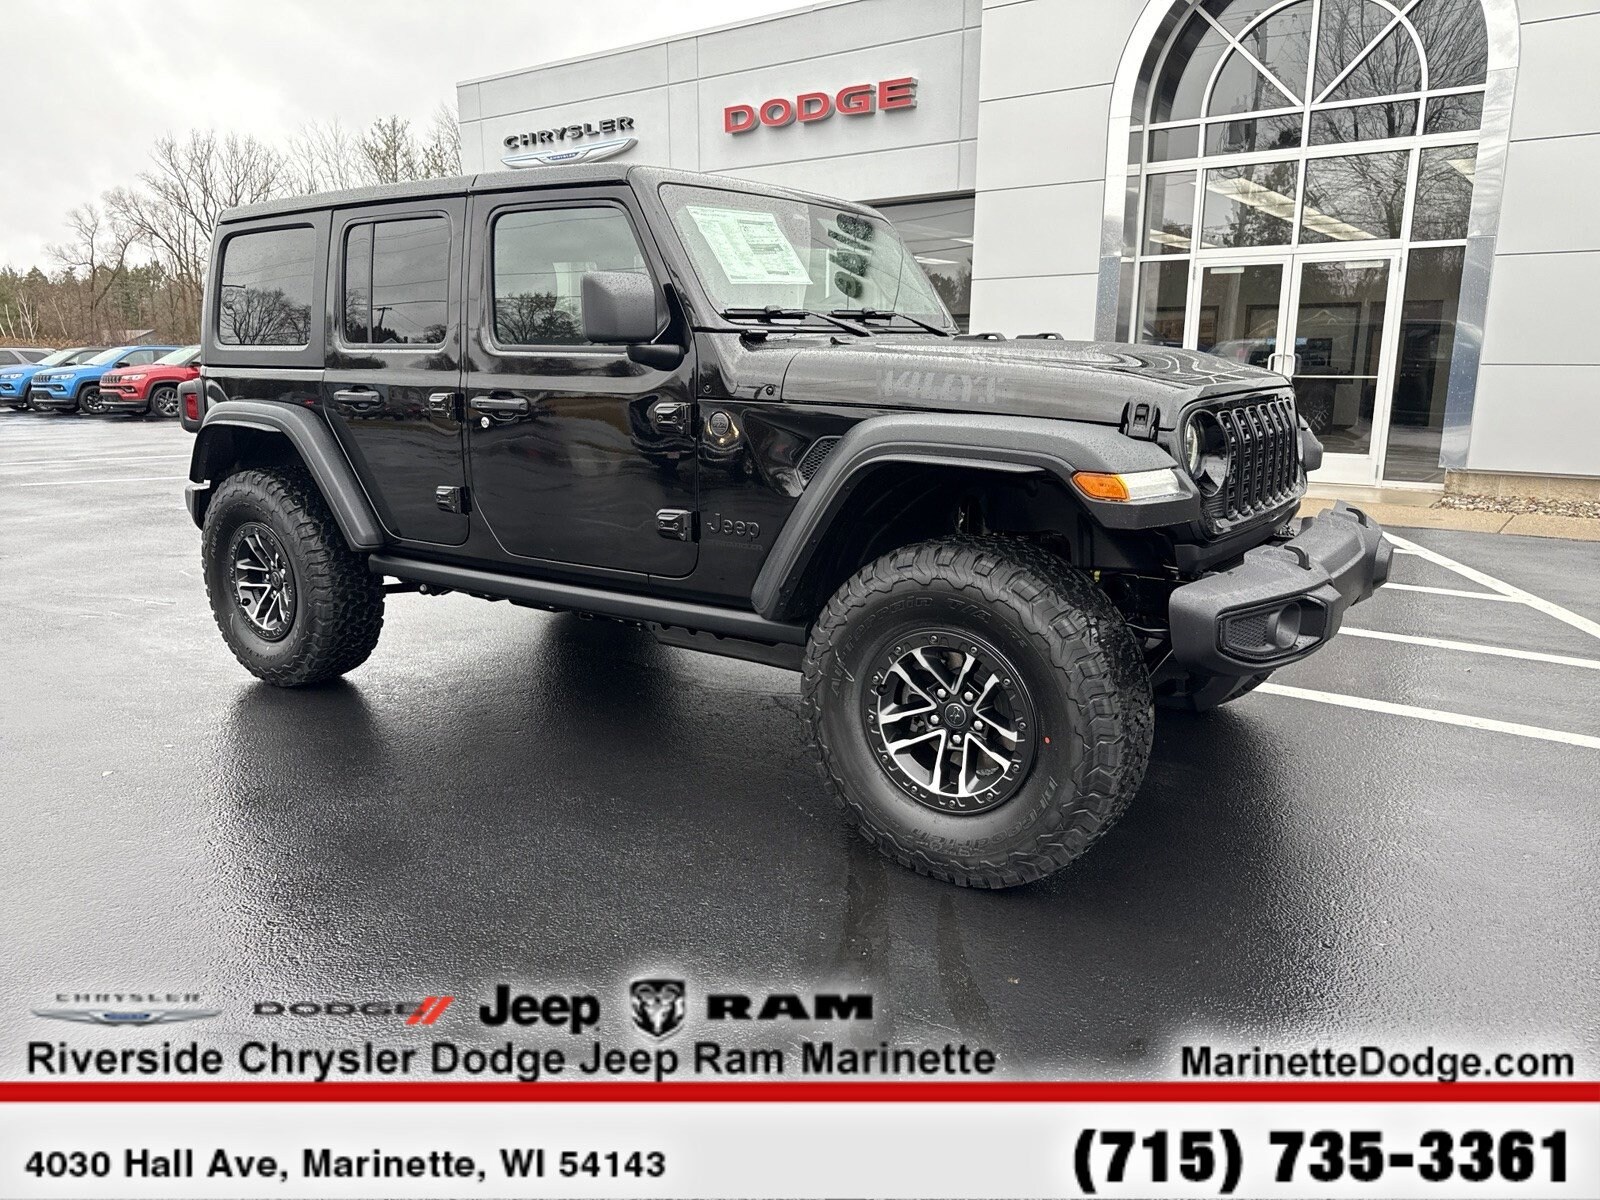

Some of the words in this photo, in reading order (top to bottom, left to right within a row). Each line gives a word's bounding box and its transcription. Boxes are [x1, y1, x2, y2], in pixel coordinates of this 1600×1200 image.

[724, 77, 918, 134] DODGE
[503, 116, 635, 149] CHRYSLER
[705, 512, 761, 542] Jeep
